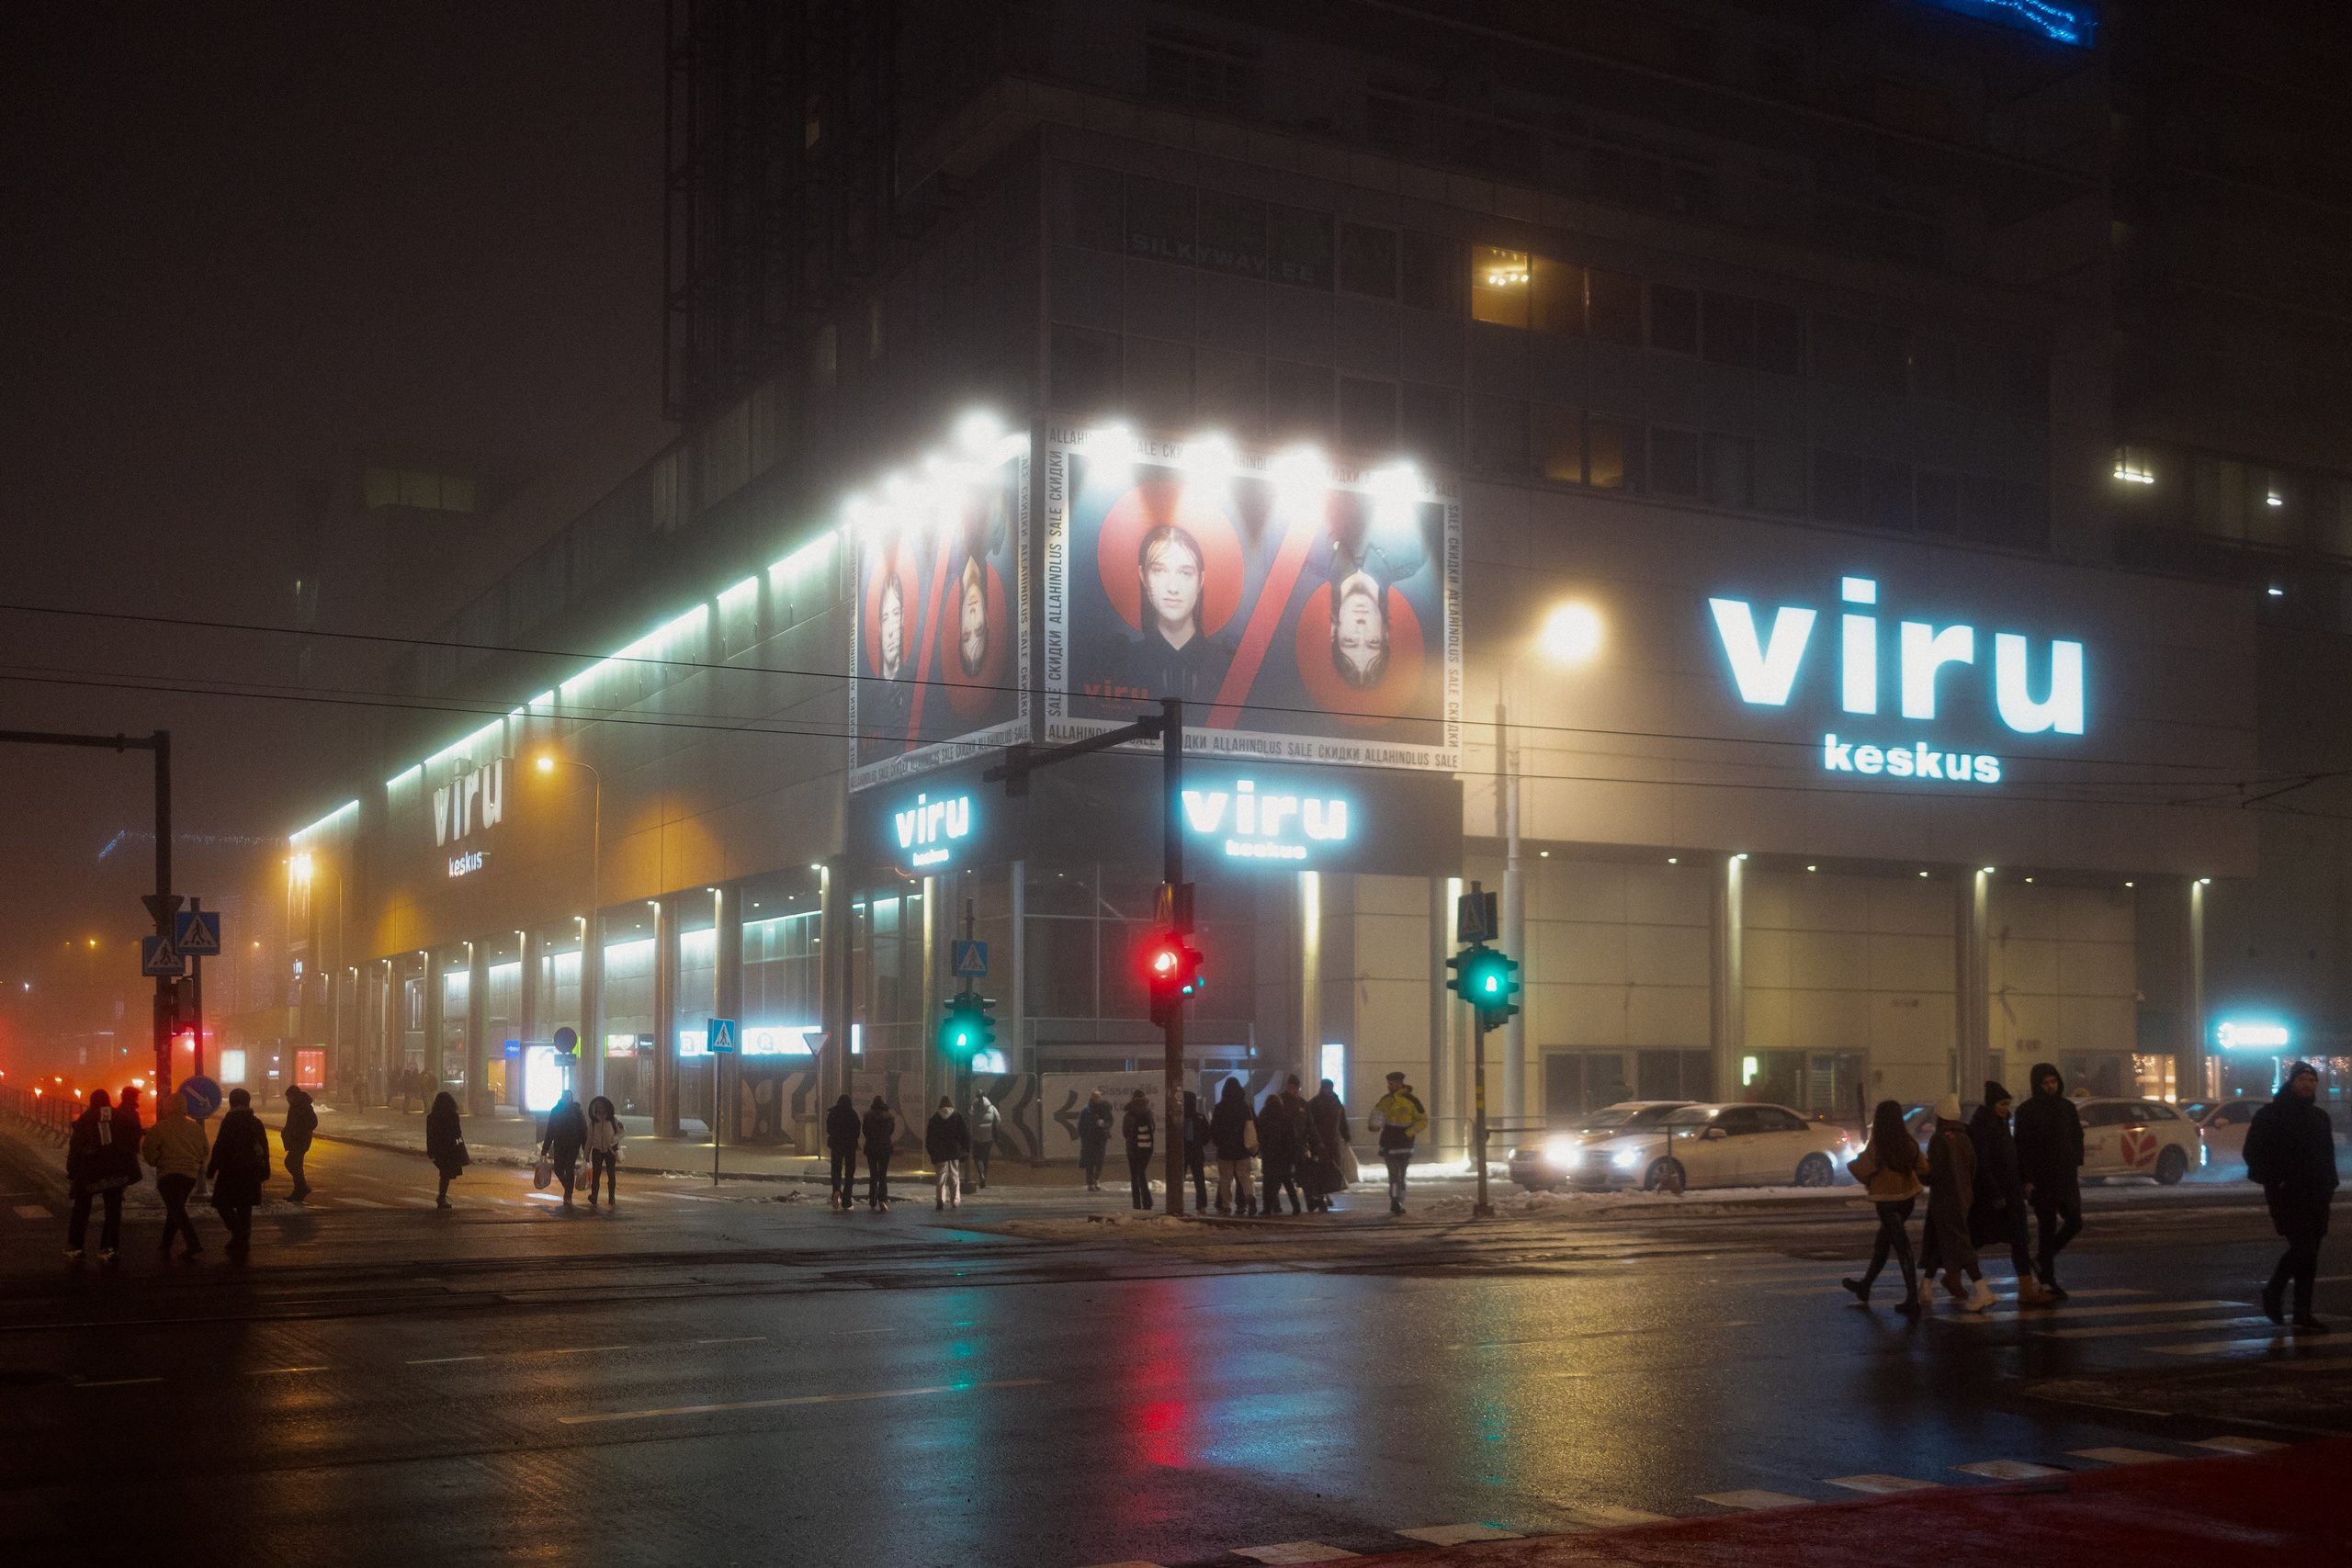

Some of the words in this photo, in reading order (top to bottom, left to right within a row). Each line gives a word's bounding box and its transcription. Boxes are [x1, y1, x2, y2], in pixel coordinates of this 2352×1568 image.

[1048, 450, 1064, 502] СКИДКИ
[1020, 486, 1029, 537] СКИДКИ
[1048, 507, 1062, 536] SALE
[1447, 504, 1459, 530] SALE
[1020, 544, 1029, 625] ALLAHINDLUS
[1048, 544, 1062, 624] ALLAHINDLUS
[1447, 537, 1459, 584] СКИДКИ
[1020, 629, 1028, 660] SALE
[1448, 589, 1459, 663] ALLAHINDLUS
[1048, 630, 1064, 681] СКИДКИ
[1709, 577, 2084, 735] viru
[1048, 687, 1062, 716] SALE
[1083, 679, 1149, 704] viru
[1448, 669, 1459, 695] SALE
[1447, 702, 1459, 748] СКИДКИ
[1213, 736, 1282, 755] ALLAHINDLUS
[1287, 742, 1313, 757] SALE
[1317, 744, 1361, 761] СКИДКИ
[1364, 748, 1430, 766] ALLAHINDLUS
[1434, 753, 1458, 768] SALE
[1825, 733, 2001, 784] keskus
[434, 757, 503, 847] viru
[895, 793, 969, 849] viru
[1181, 779, 1347, 840] viru
[448, 851, 483, 878] keskus
